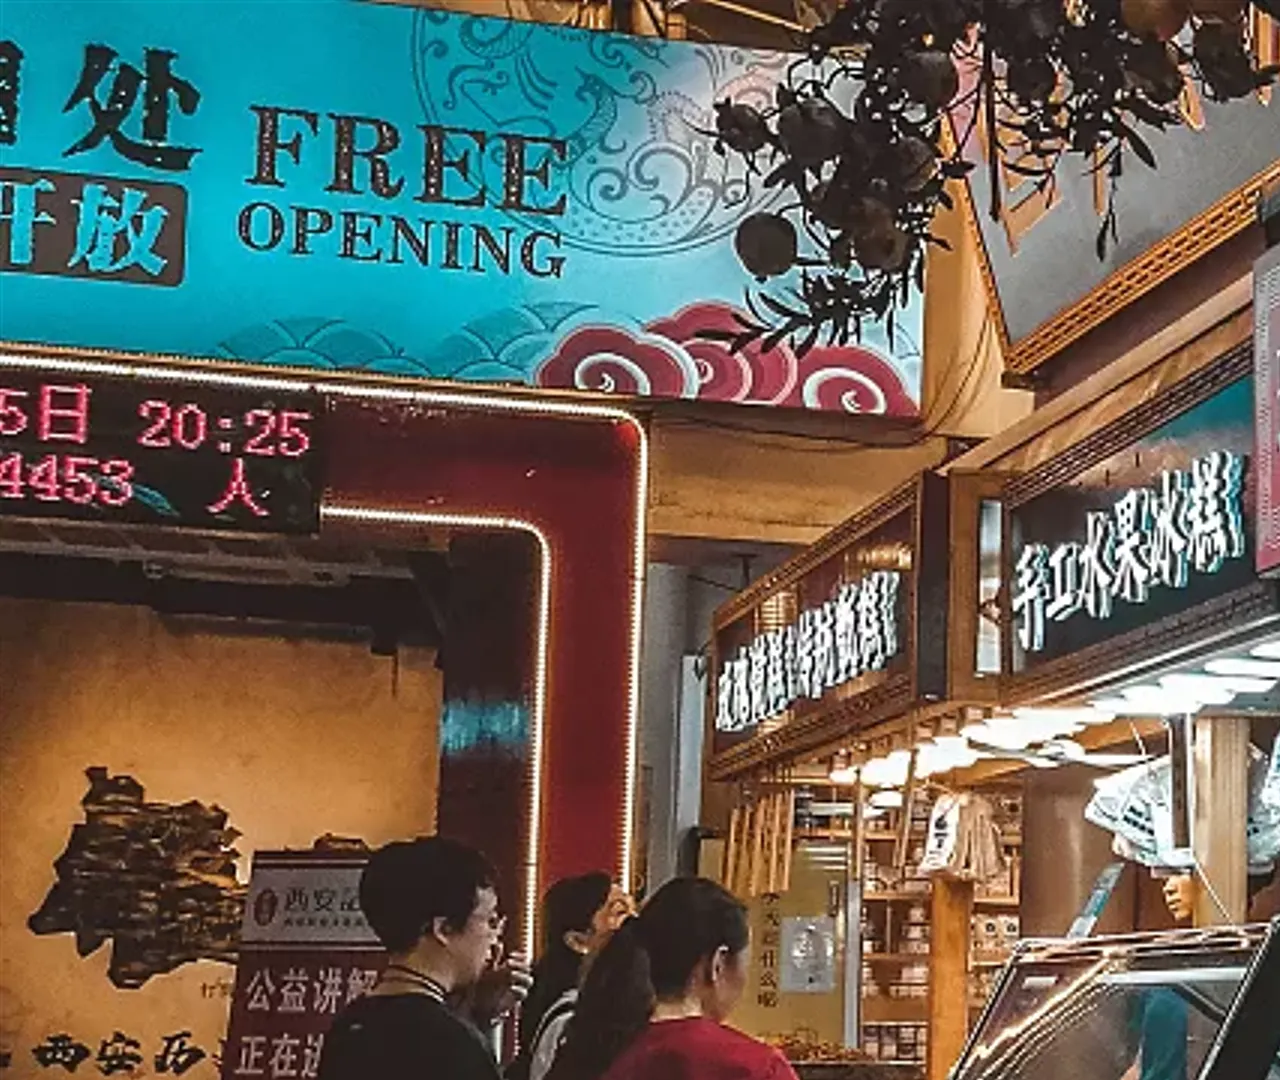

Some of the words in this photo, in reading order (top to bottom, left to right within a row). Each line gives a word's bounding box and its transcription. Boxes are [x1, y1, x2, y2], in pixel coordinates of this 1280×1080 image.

[0, 40, 203, 172] 处
[244, 104, 569, 217] FREE
[238, 201, 566, 279] OPENING
[137, 399, 312, 456] 20:25
[207, 457, 270, 516] 人
[246, 968, 378, 1014] 公益讲解
